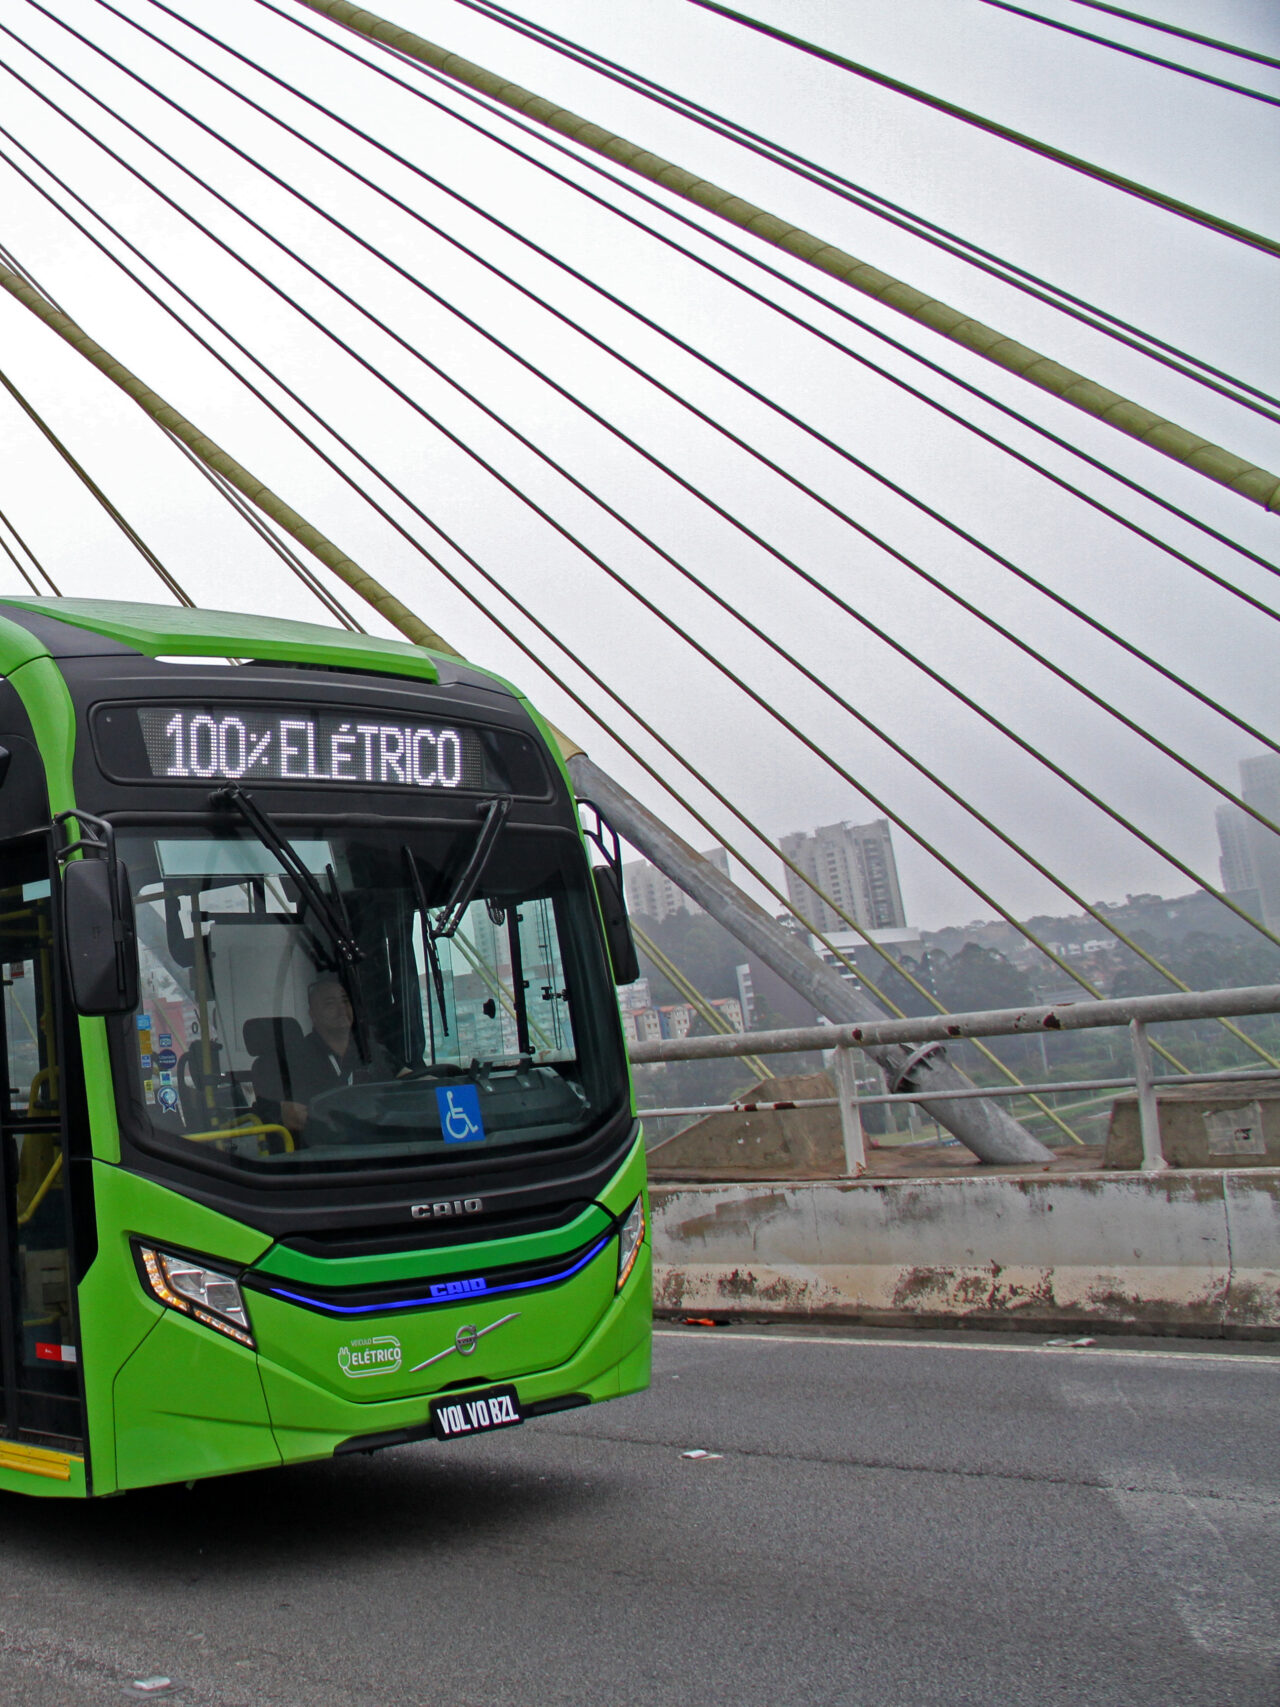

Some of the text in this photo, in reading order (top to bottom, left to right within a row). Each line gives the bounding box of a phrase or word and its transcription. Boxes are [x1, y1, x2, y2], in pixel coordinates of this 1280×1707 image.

[167, 714, 460, 787] 100% ELÉTRICO
[411, 1198, 483, 1219] CAIO
[429, 1277, 487, 1298] CAIO
[352, 1348, 401, 1365] ELÉTRICO
[488, 1395, 520, 1424] BZL
